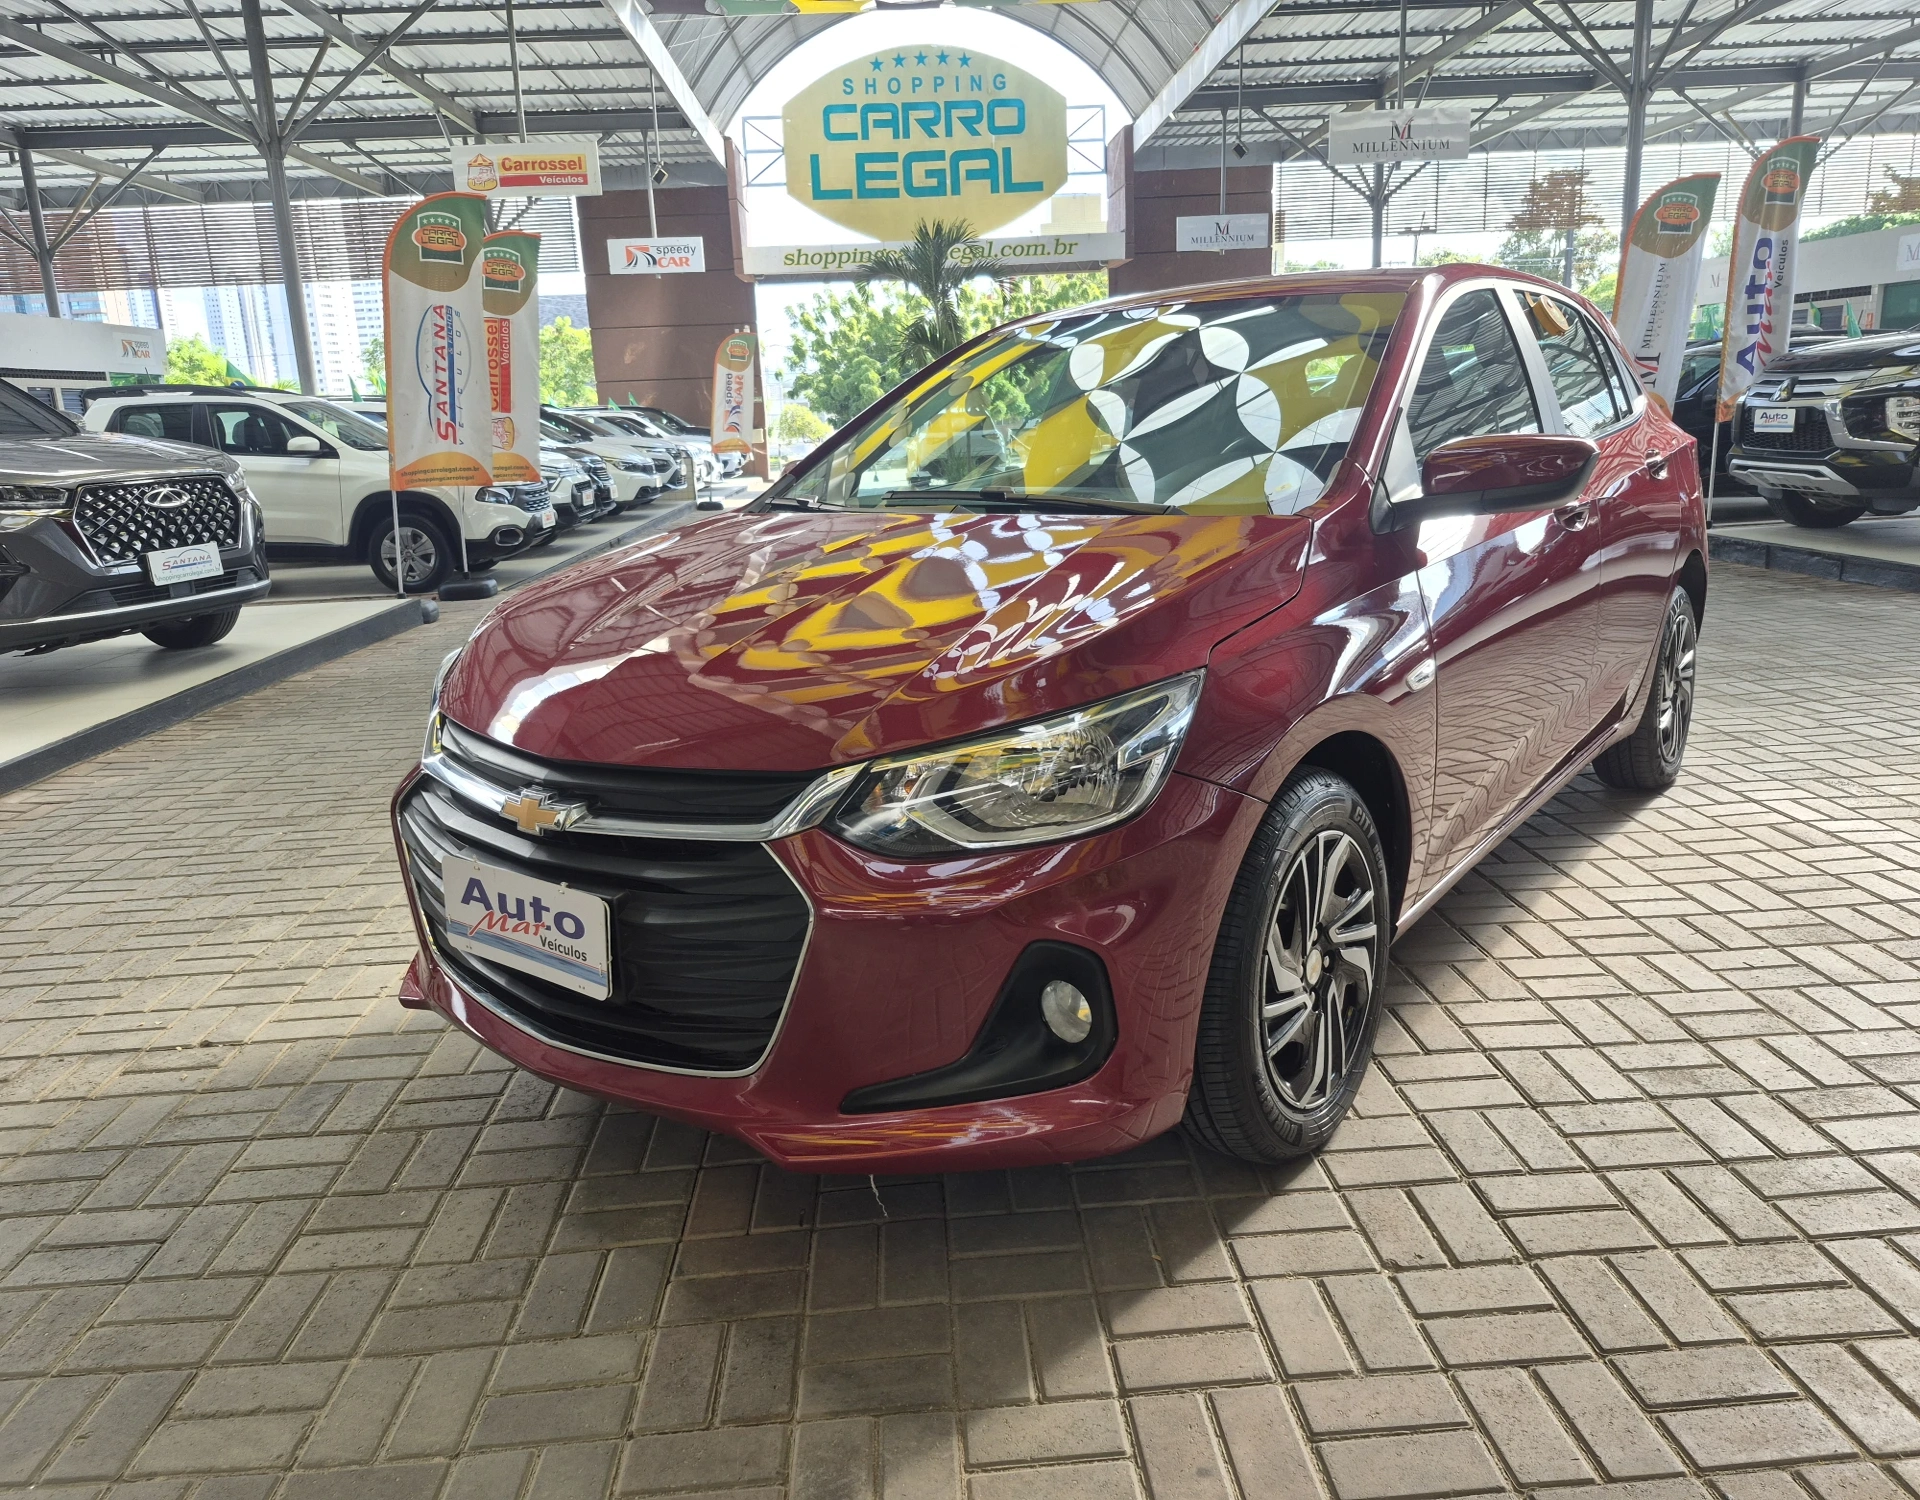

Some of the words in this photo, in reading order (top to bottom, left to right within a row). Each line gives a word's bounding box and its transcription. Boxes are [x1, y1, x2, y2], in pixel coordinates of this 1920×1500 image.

[842, 73, 1007, 96] SHOPPING
[822, 98, 1026, 142] CARRO
[1352, 139, 1451, 154] MILLENNIUM
[501, 156, 583, 171] Carrossel
[810, 147, 1044, 200] LEGAL
[539, 175, 584, 184] Veículos
[1661, 212, 1693, 220] LEGAL
[420, 236, 461, 247] LEGAL
[422, 228, 459, 238] CARRO
[1191, 234, 1255, 244] MILLENNIUM
[656, 243, 696, 256] speedy
[485, 267, 519, 278] LEGAL
[486, 261, 518, 270] CARRO
[657, 256, 690, 269] CAR
[1774, 239, 1789, 289] Veículos
[1641, 262, 1667, 349] MILLENNIUM
[1736, 237, 1773, 377] Auto
[501, 320, 510, 366] Veículos
[136, 350, 151, 358] CAR
[433, 304, 458, 445] SANTANA
[454, 309, 464, 446] VEÍCULOS
[734, 374, 744, 406] CAR
[1760, 412, 1788, 420] Auto
[162, 554, 212, 571] SANTANA
[1354, 806, 1376, 839] CITY
[460, 877, 586, 940] Auto
[467, 909, 547, 937] Mar
[539, 934, 588, 962] Veículos
